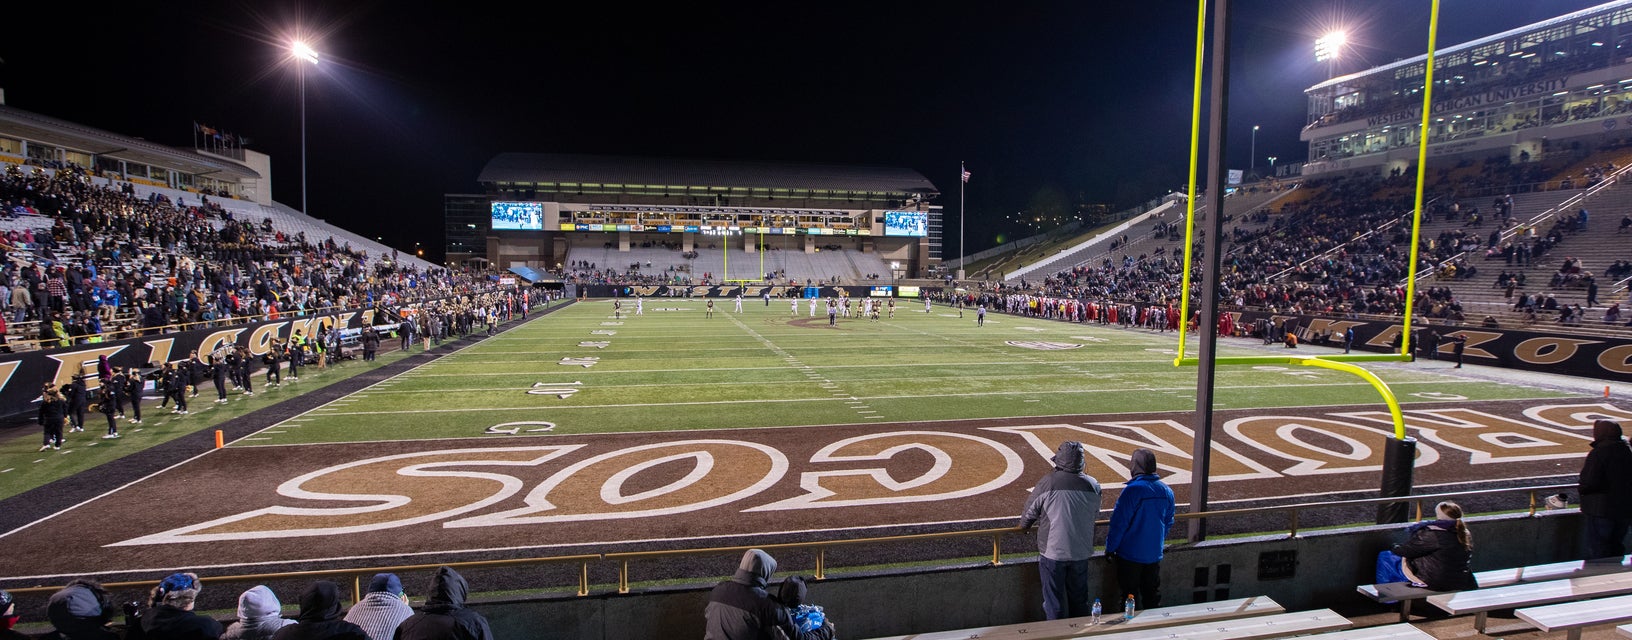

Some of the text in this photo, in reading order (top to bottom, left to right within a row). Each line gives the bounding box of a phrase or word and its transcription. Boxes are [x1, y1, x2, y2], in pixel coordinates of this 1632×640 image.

[1367, 108, 1415, 127] WESTERN
[1485, 77, 1569, 102] UNIVERSITY
[0, 311, 357, 403] ELCOME
